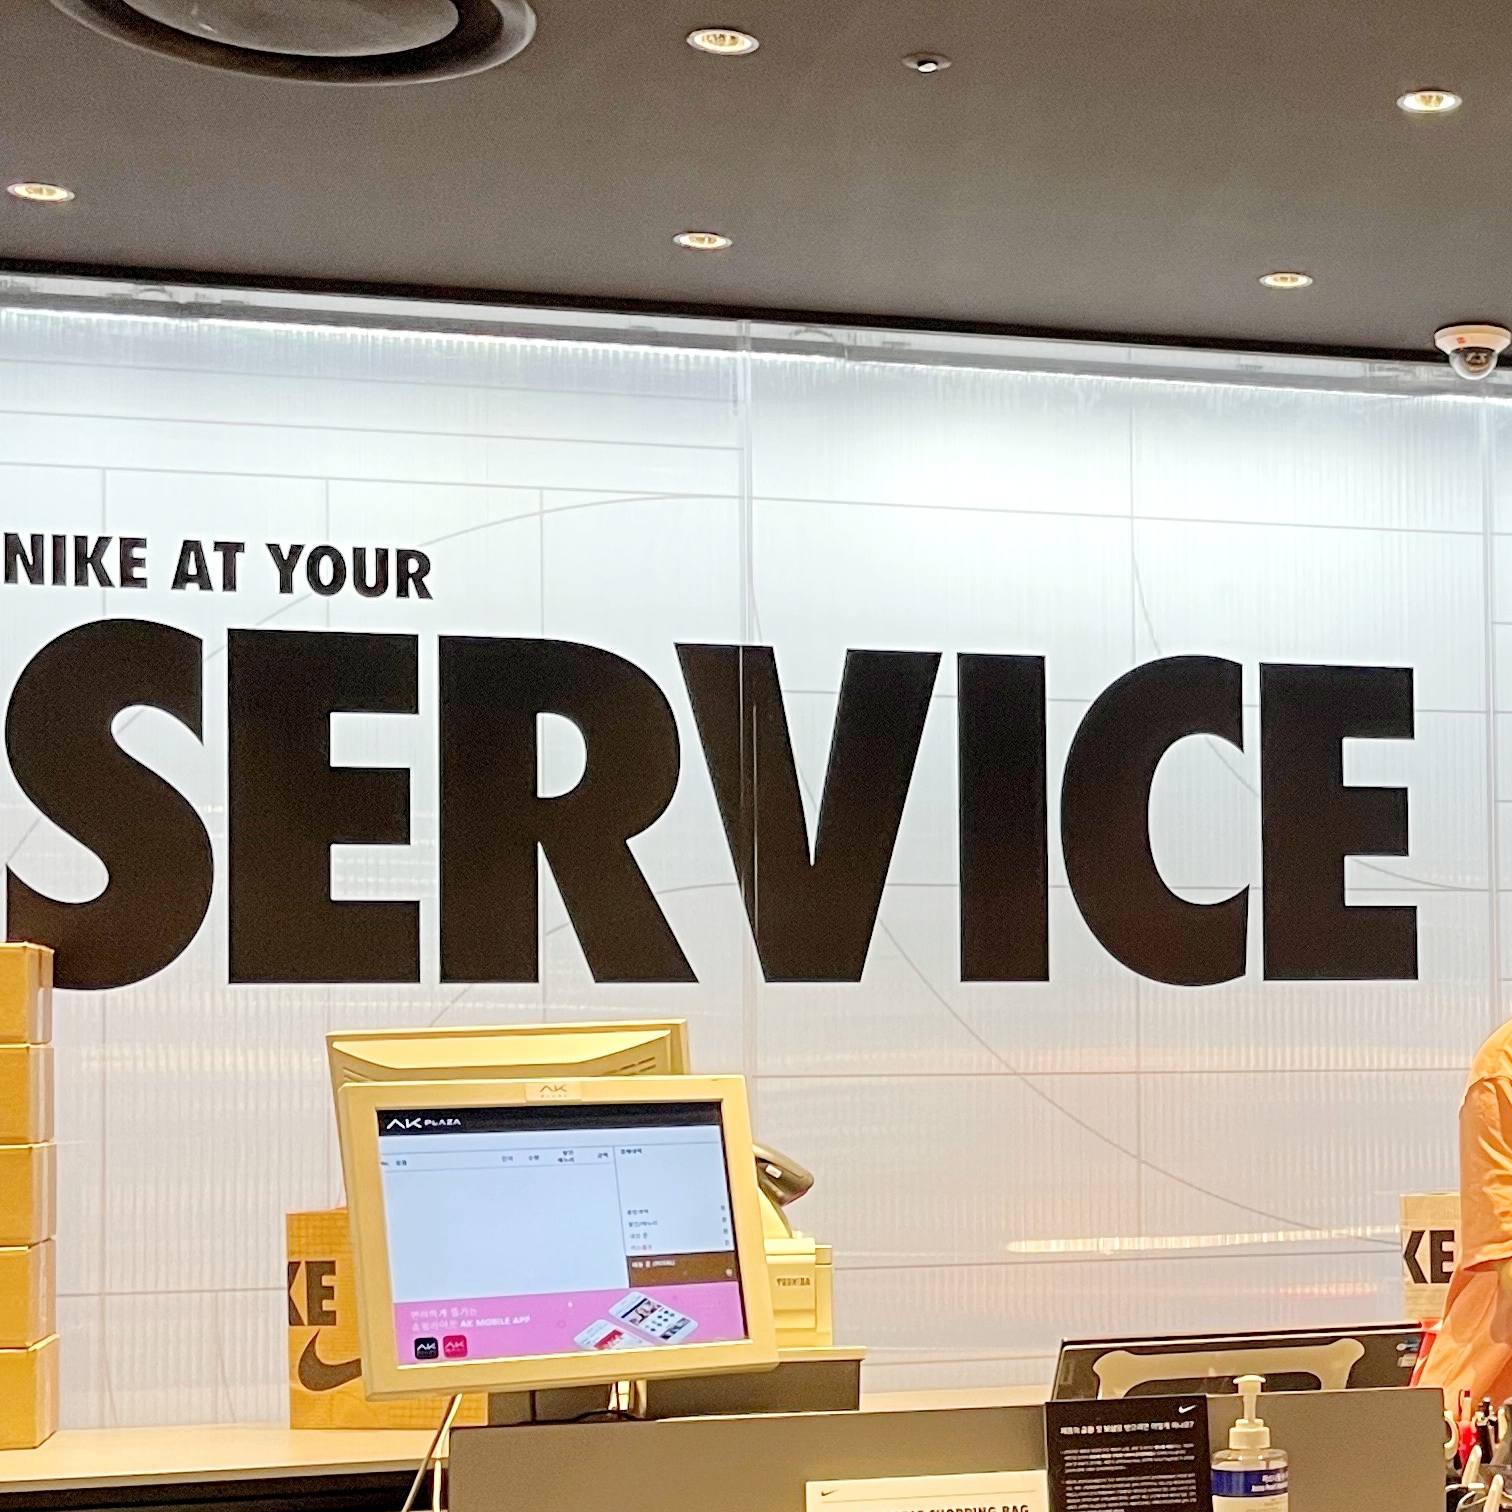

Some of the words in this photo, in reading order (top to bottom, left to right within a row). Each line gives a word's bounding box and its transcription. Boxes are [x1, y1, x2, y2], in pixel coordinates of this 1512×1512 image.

[3, 532, 149, 588] NIKE
[171, 539, 245, 592] AT
[266, 543, 434, 600] YOUR
[4, 618, 1418, 990] SERVICE
[386, 1117, 422, 1130] AK
